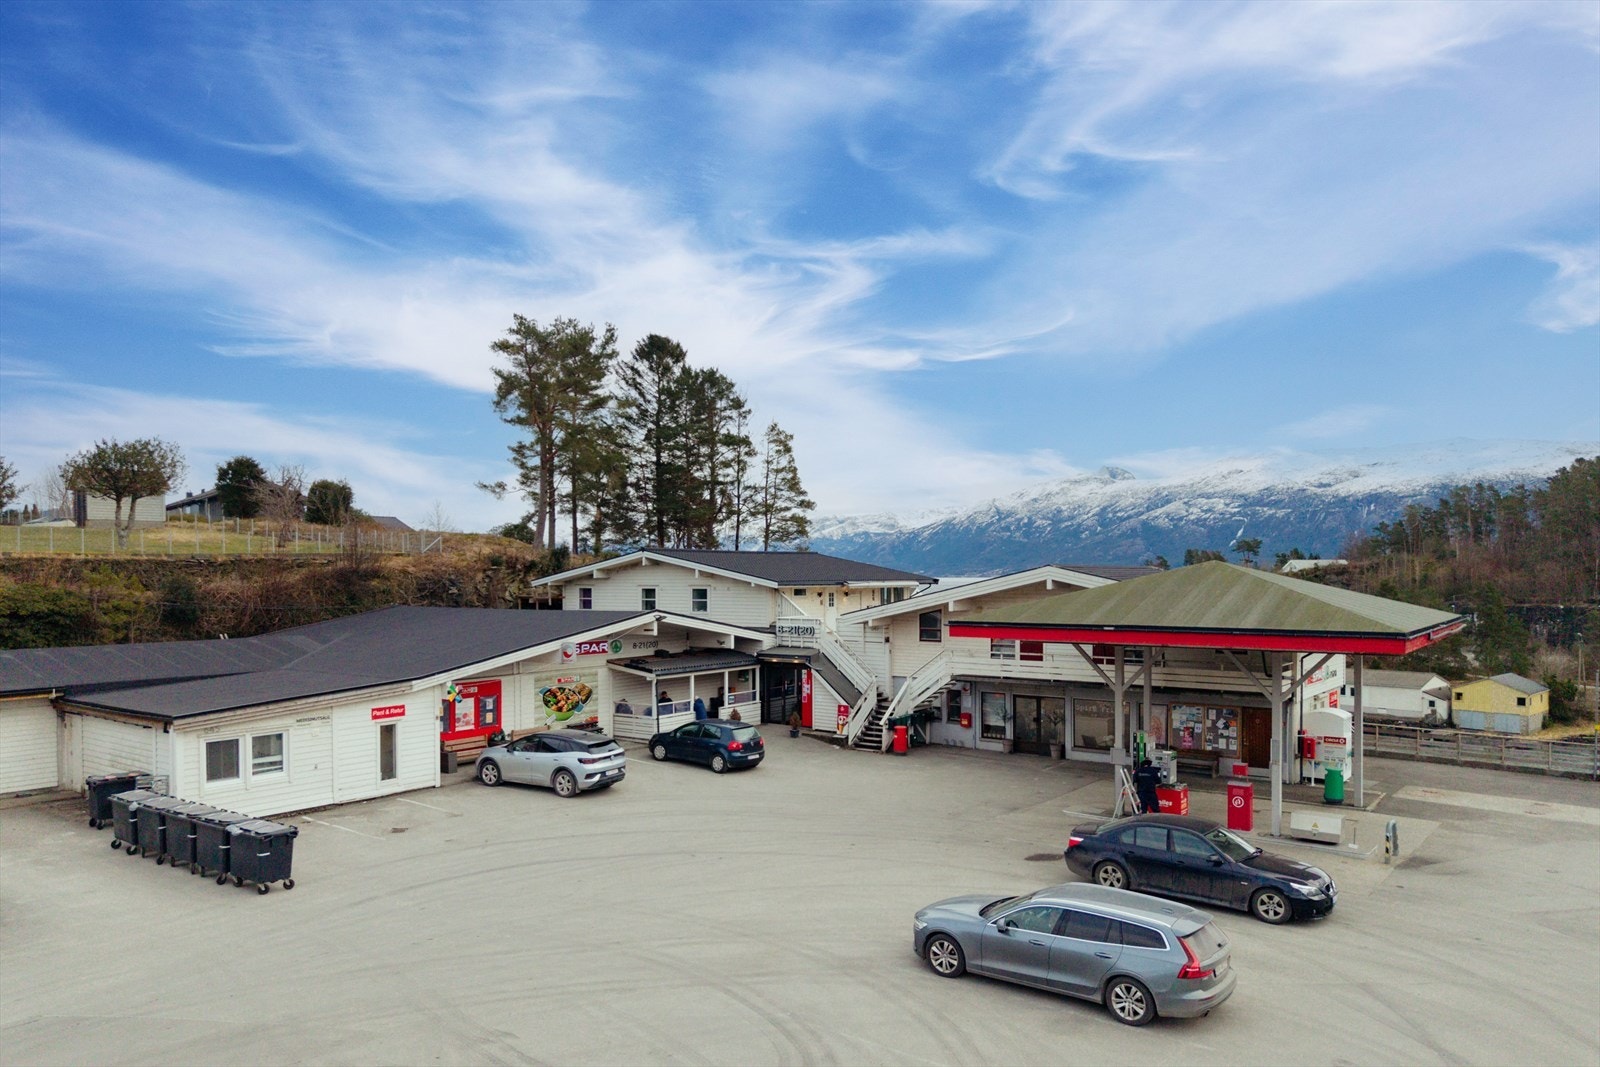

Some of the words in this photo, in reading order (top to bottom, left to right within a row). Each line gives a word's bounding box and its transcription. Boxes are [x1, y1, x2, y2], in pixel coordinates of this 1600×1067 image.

[778, 626, 815, 636] 8-21(20)
[576, 643, 608, 654] SPAR
[633, 641, 659, 649] 8-21(20)
